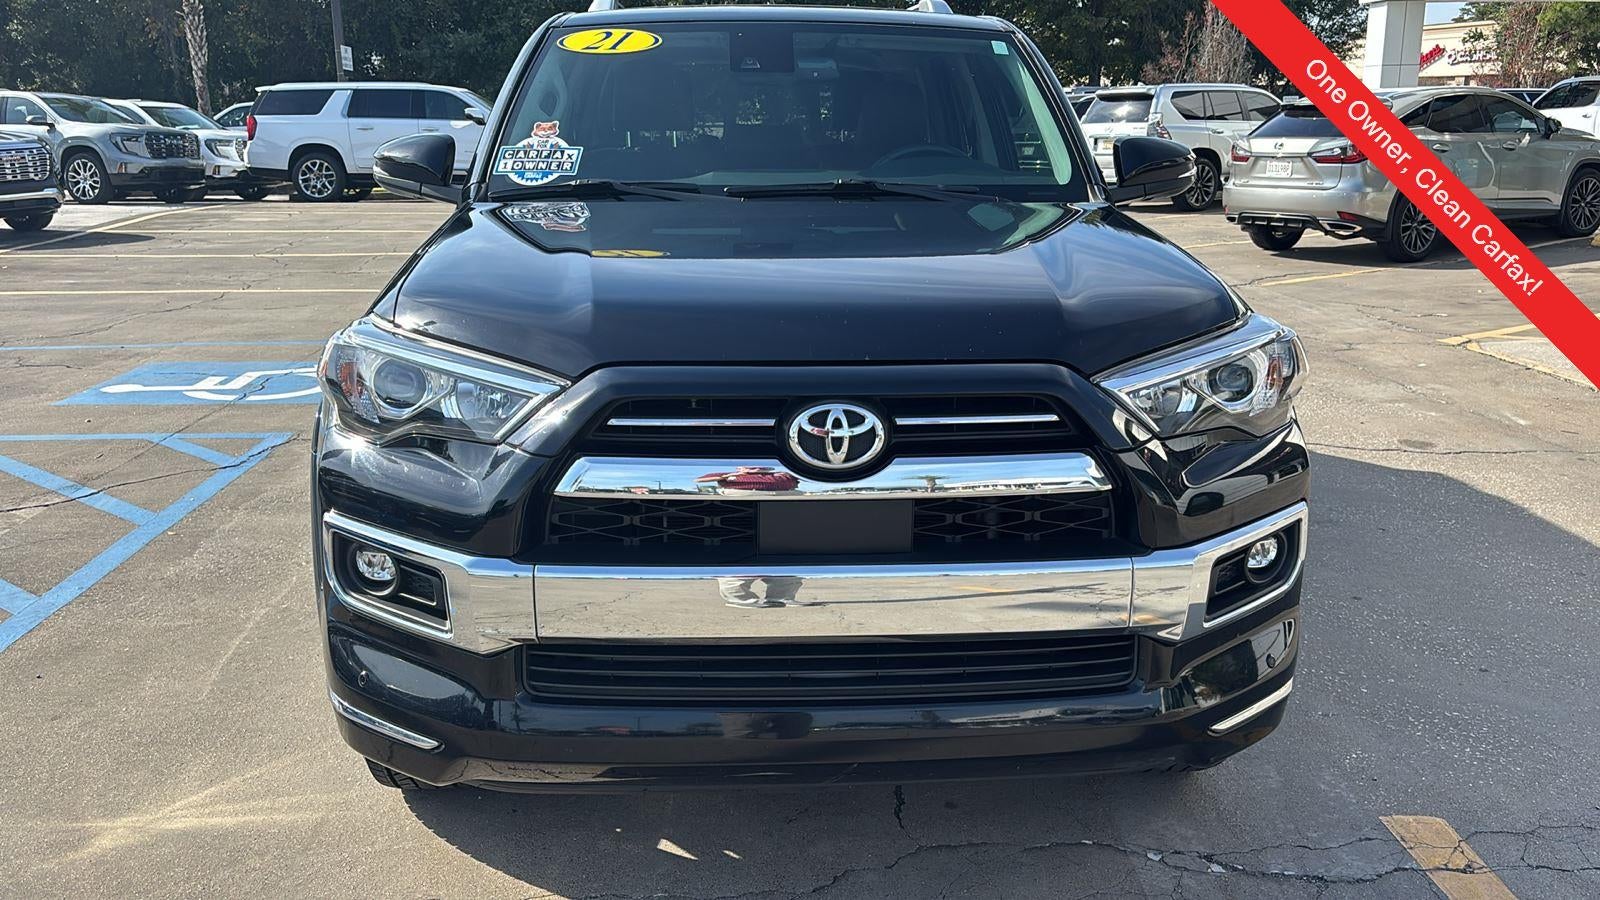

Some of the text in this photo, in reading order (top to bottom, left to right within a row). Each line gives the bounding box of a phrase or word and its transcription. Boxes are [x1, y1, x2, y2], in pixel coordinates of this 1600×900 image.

[581, 31, 634, 50] 21
[504, 150, 575, 161] CARFAX
[501, 161, 573, 170] 1 OWNER
